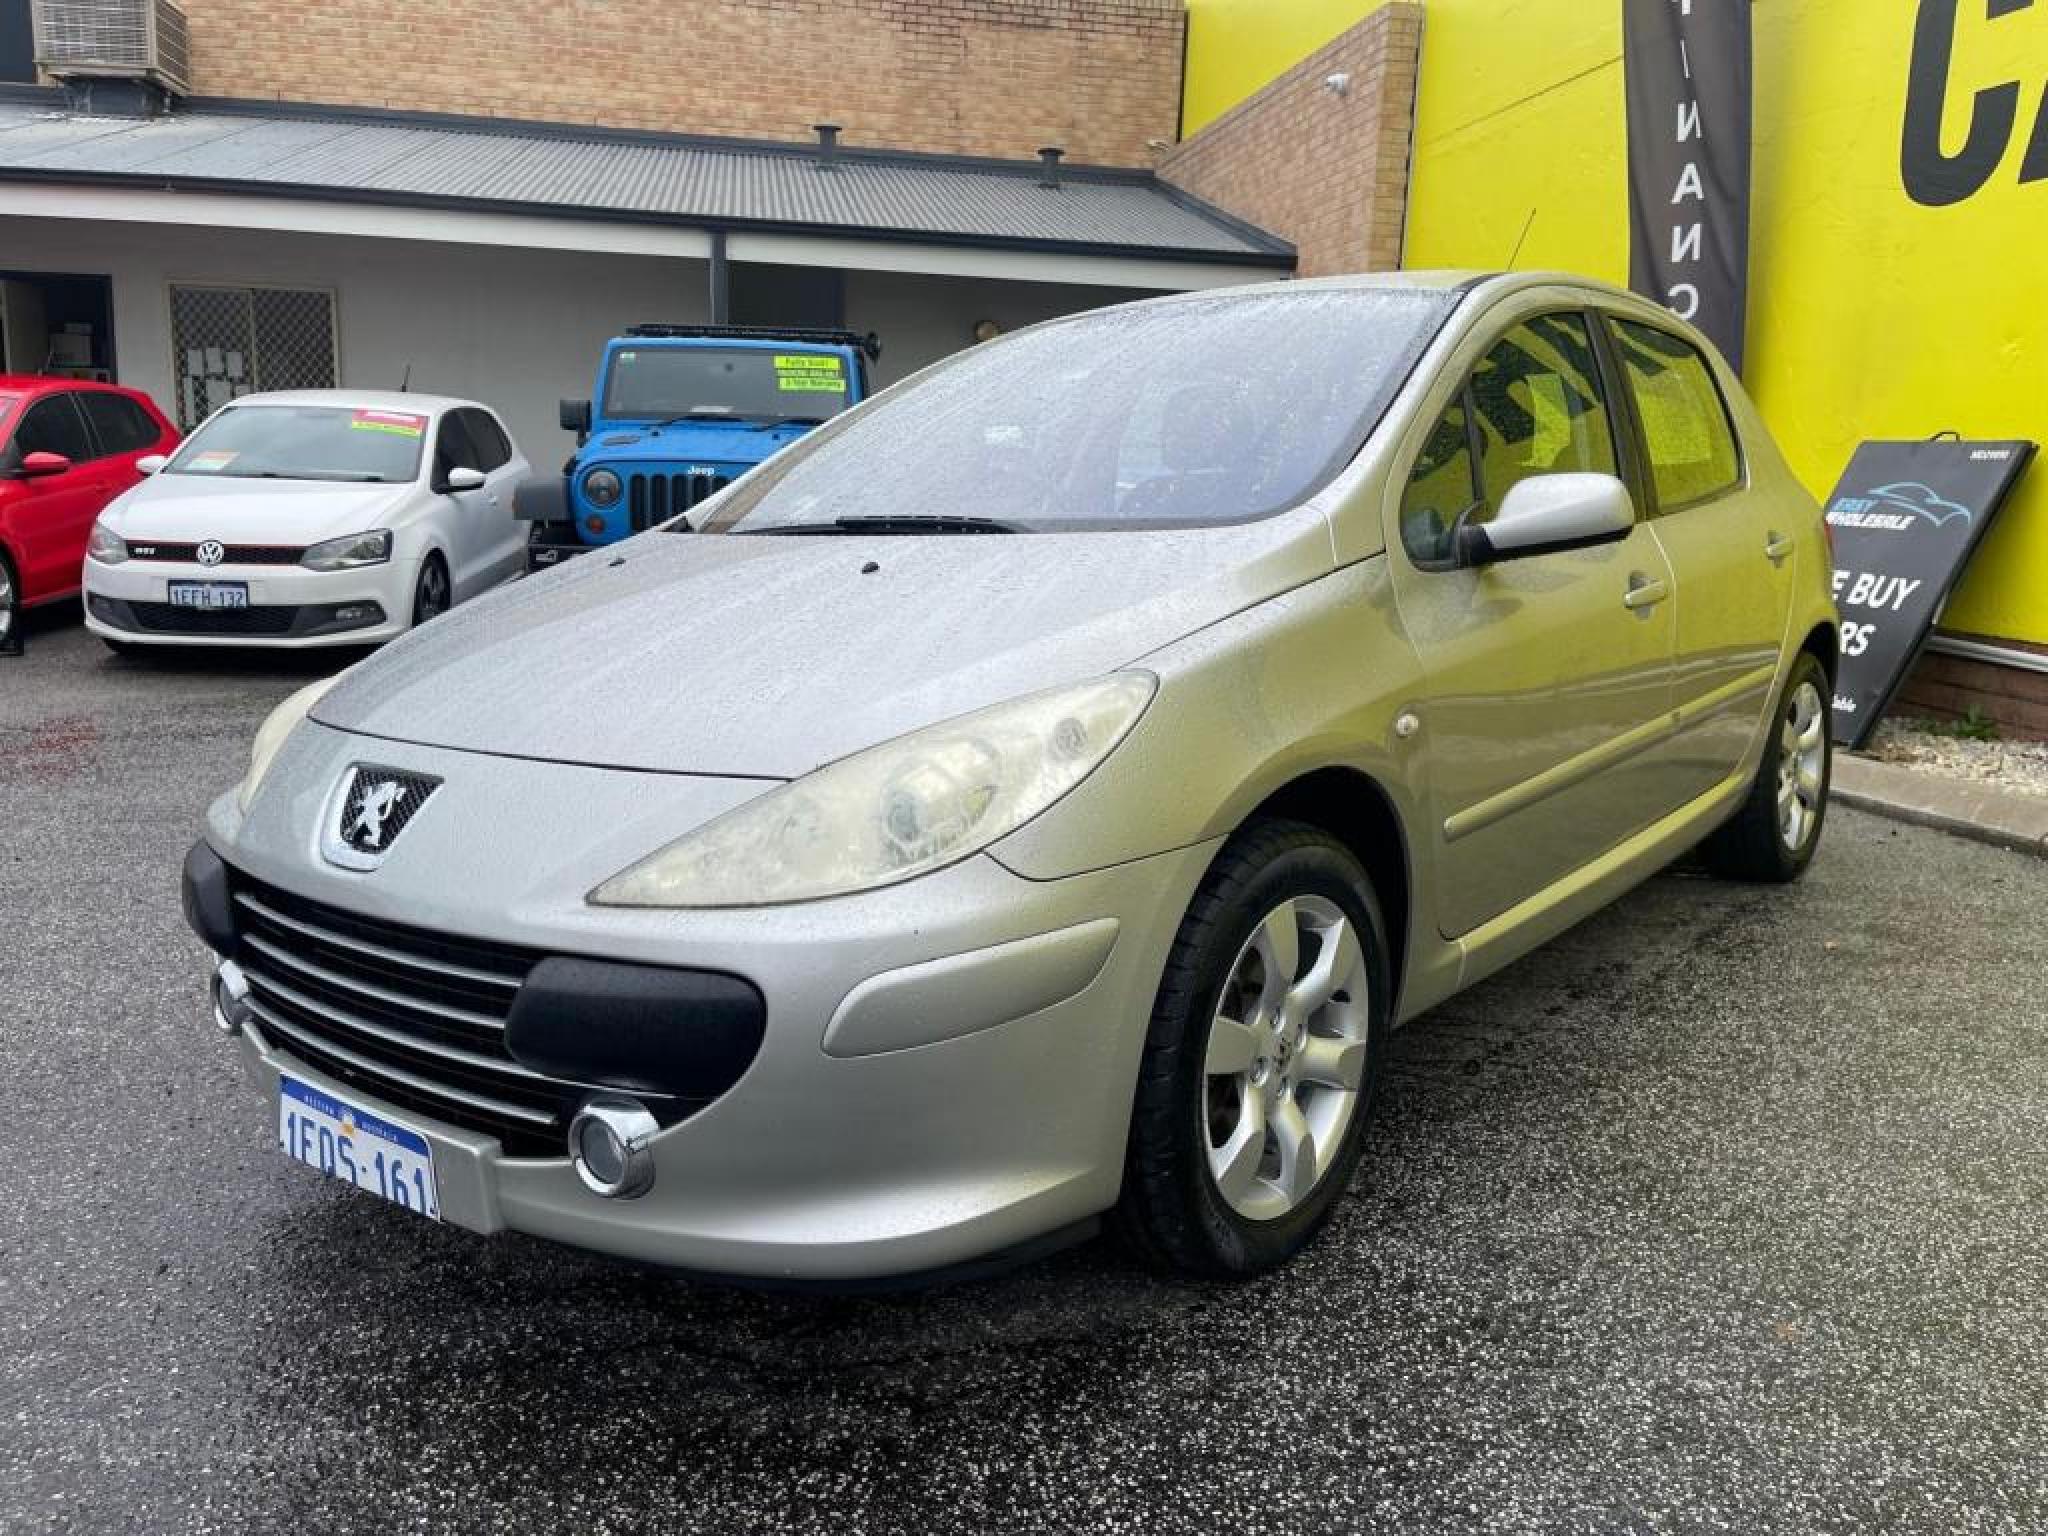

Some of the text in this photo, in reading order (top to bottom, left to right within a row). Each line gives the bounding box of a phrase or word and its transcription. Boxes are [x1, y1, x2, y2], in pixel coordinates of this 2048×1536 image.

[1900, 0, 2048, 207] C
[688, 465, 715, 477] Jeep
[1846, 573, 1921, 611] BUY
[1839, 621, 1877, 656] RS
